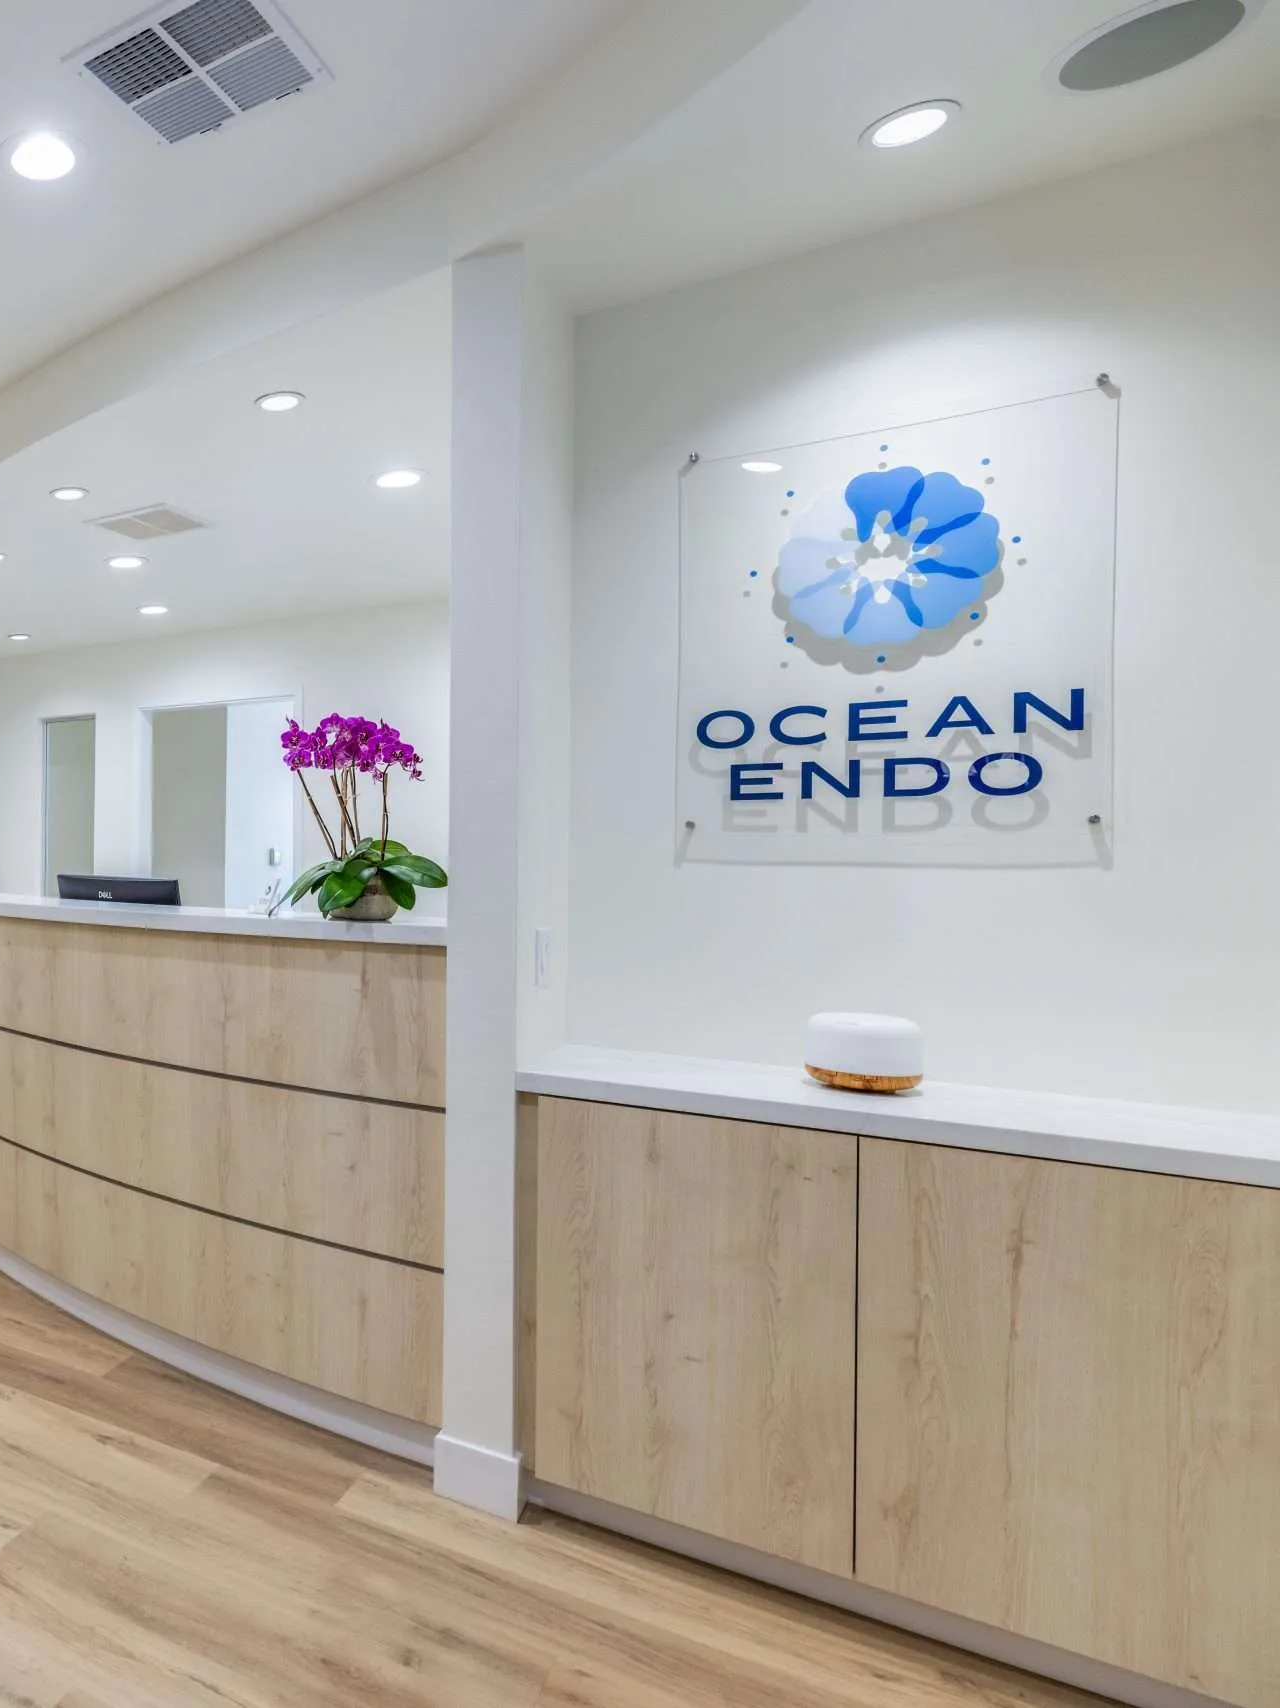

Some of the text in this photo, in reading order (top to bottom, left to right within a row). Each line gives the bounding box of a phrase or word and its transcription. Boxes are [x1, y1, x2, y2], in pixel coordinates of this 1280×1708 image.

[697, 688, 1084, 749] OCEAN
[730, 753, 1042, 800] ENDO
[98, 891, 113, 899] DELL
